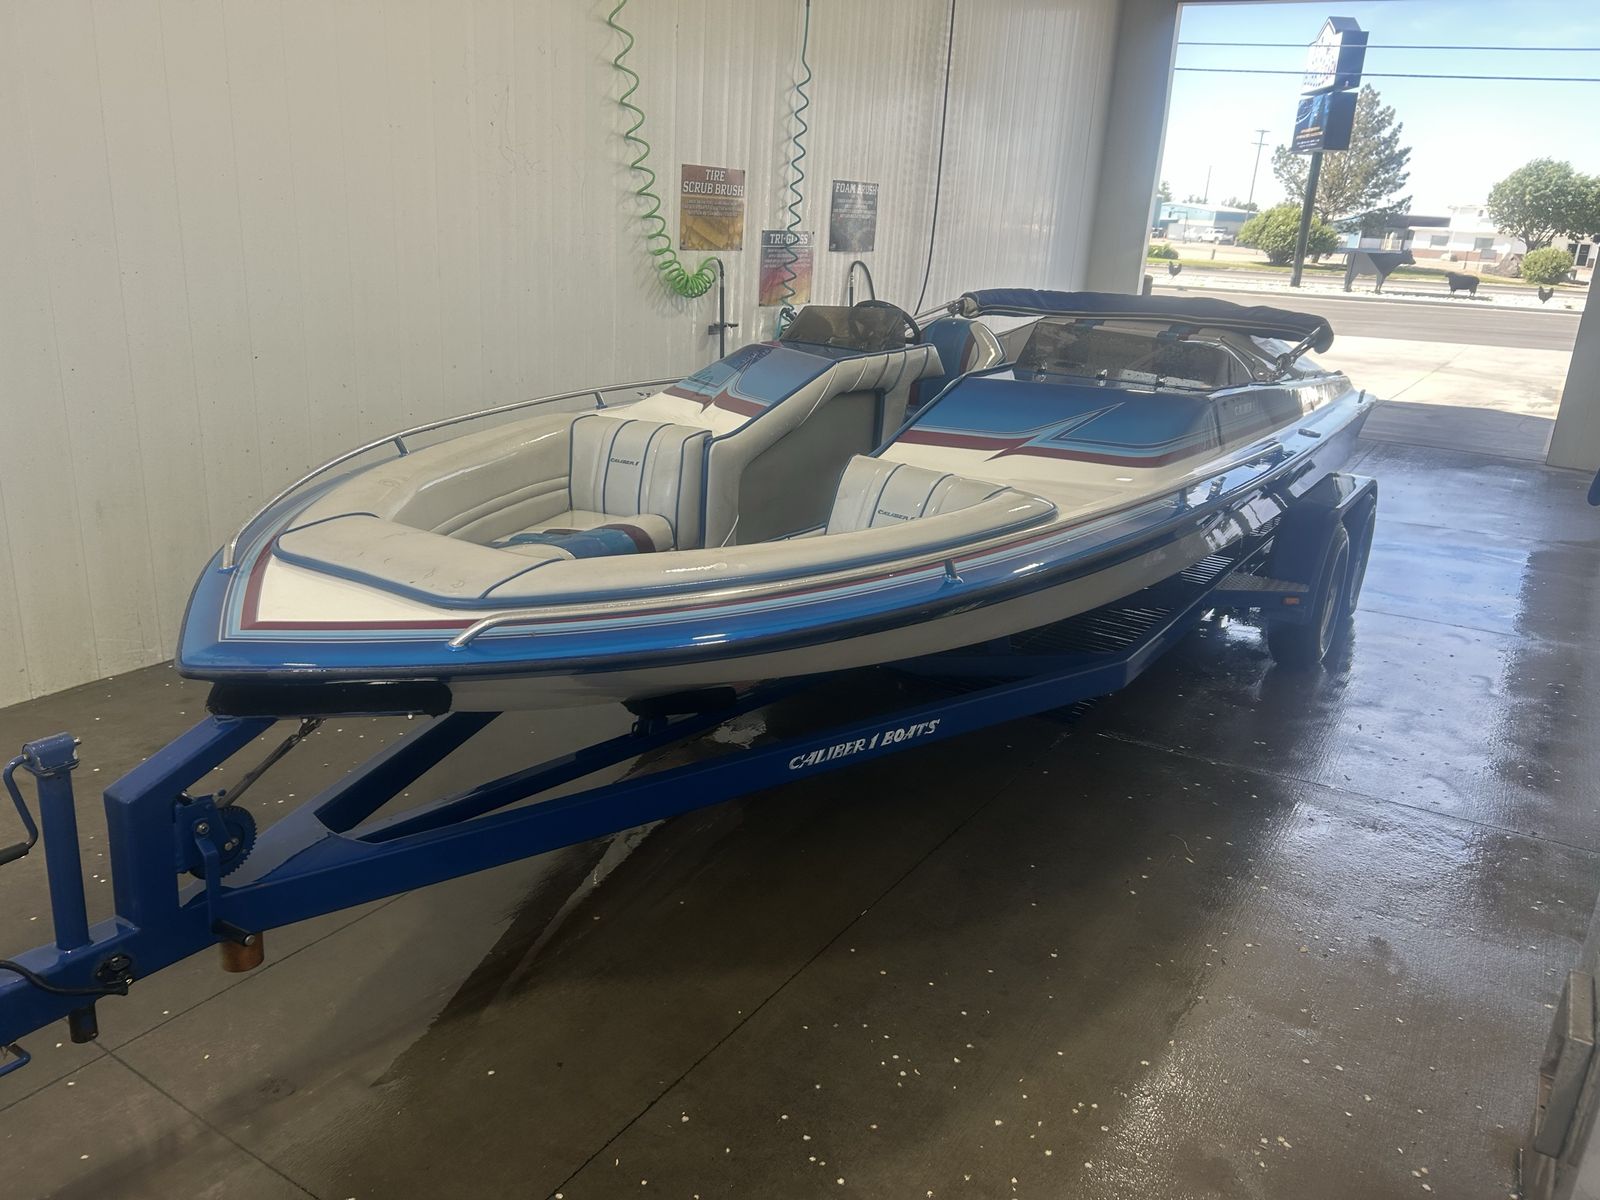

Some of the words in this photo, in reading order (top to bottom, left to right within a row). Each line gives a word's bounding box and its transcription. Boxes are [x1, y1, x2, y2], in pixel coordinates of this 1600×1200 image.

[705, 168, 726, 182] TIRE
[682, 180, 713, 194] SCRUB
[714, 183, 744, 197] BRUSH
[835, 182, 856, 194] FOAM
[788, 738, 866, 770] CALIBER
[869, 732, 880, 750] 1
[881, 718, 941, 747] BOATS
